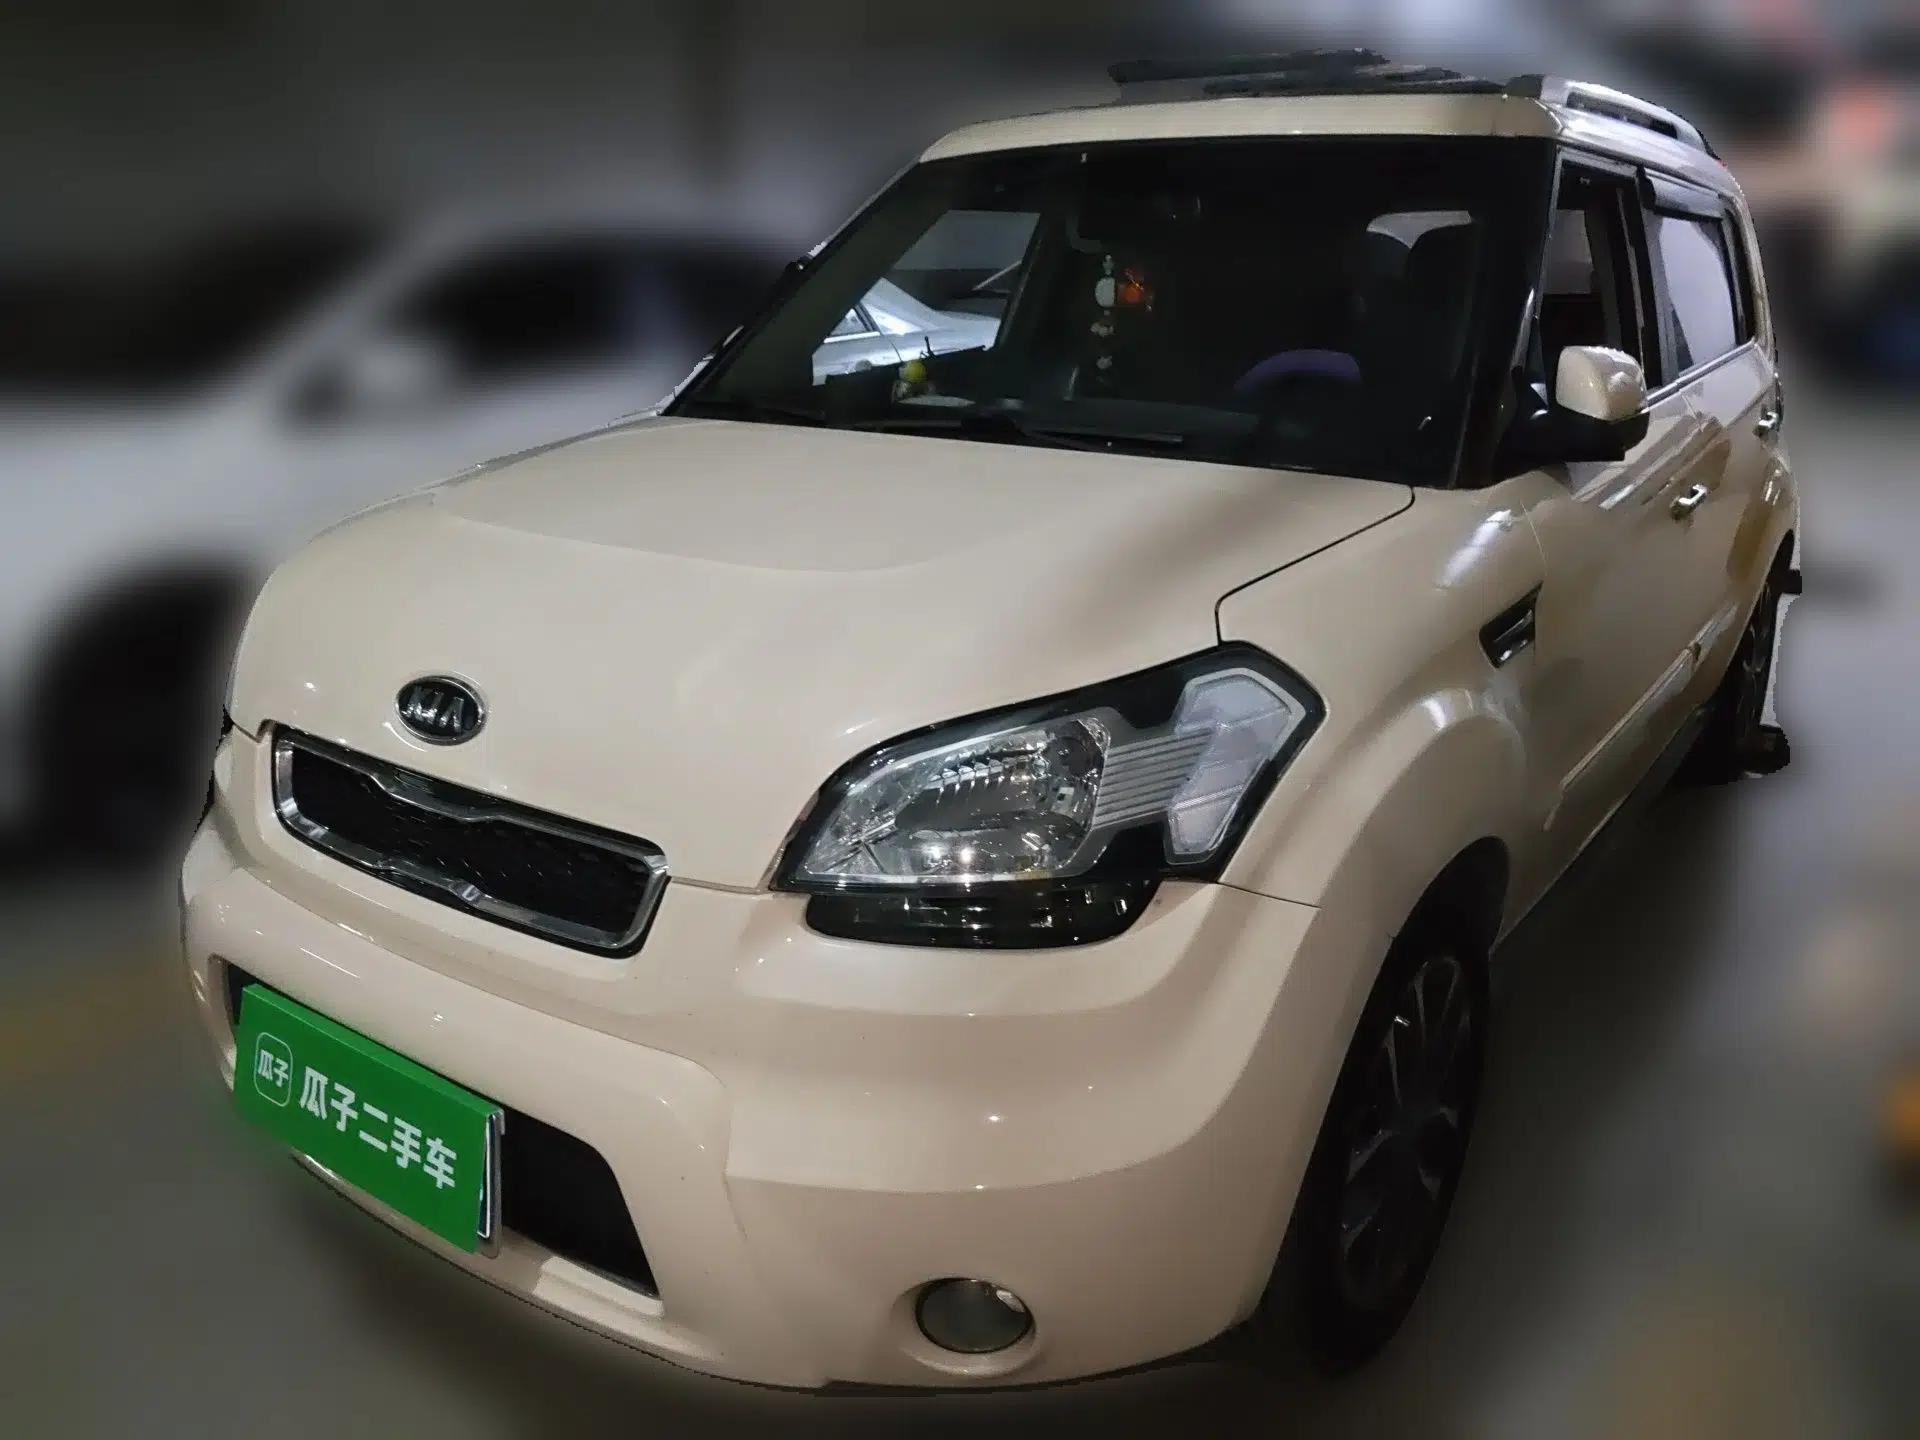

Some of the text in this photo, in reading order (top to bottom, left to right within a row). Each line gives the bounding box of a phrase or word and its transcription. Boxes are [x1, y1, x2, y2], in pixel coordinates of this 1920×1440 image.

[402, 684, 468, 735] KIA
[257, 1049, 289, 1087] 瓜子
[300, 1066, 457, 1189] 瓜子二手车
